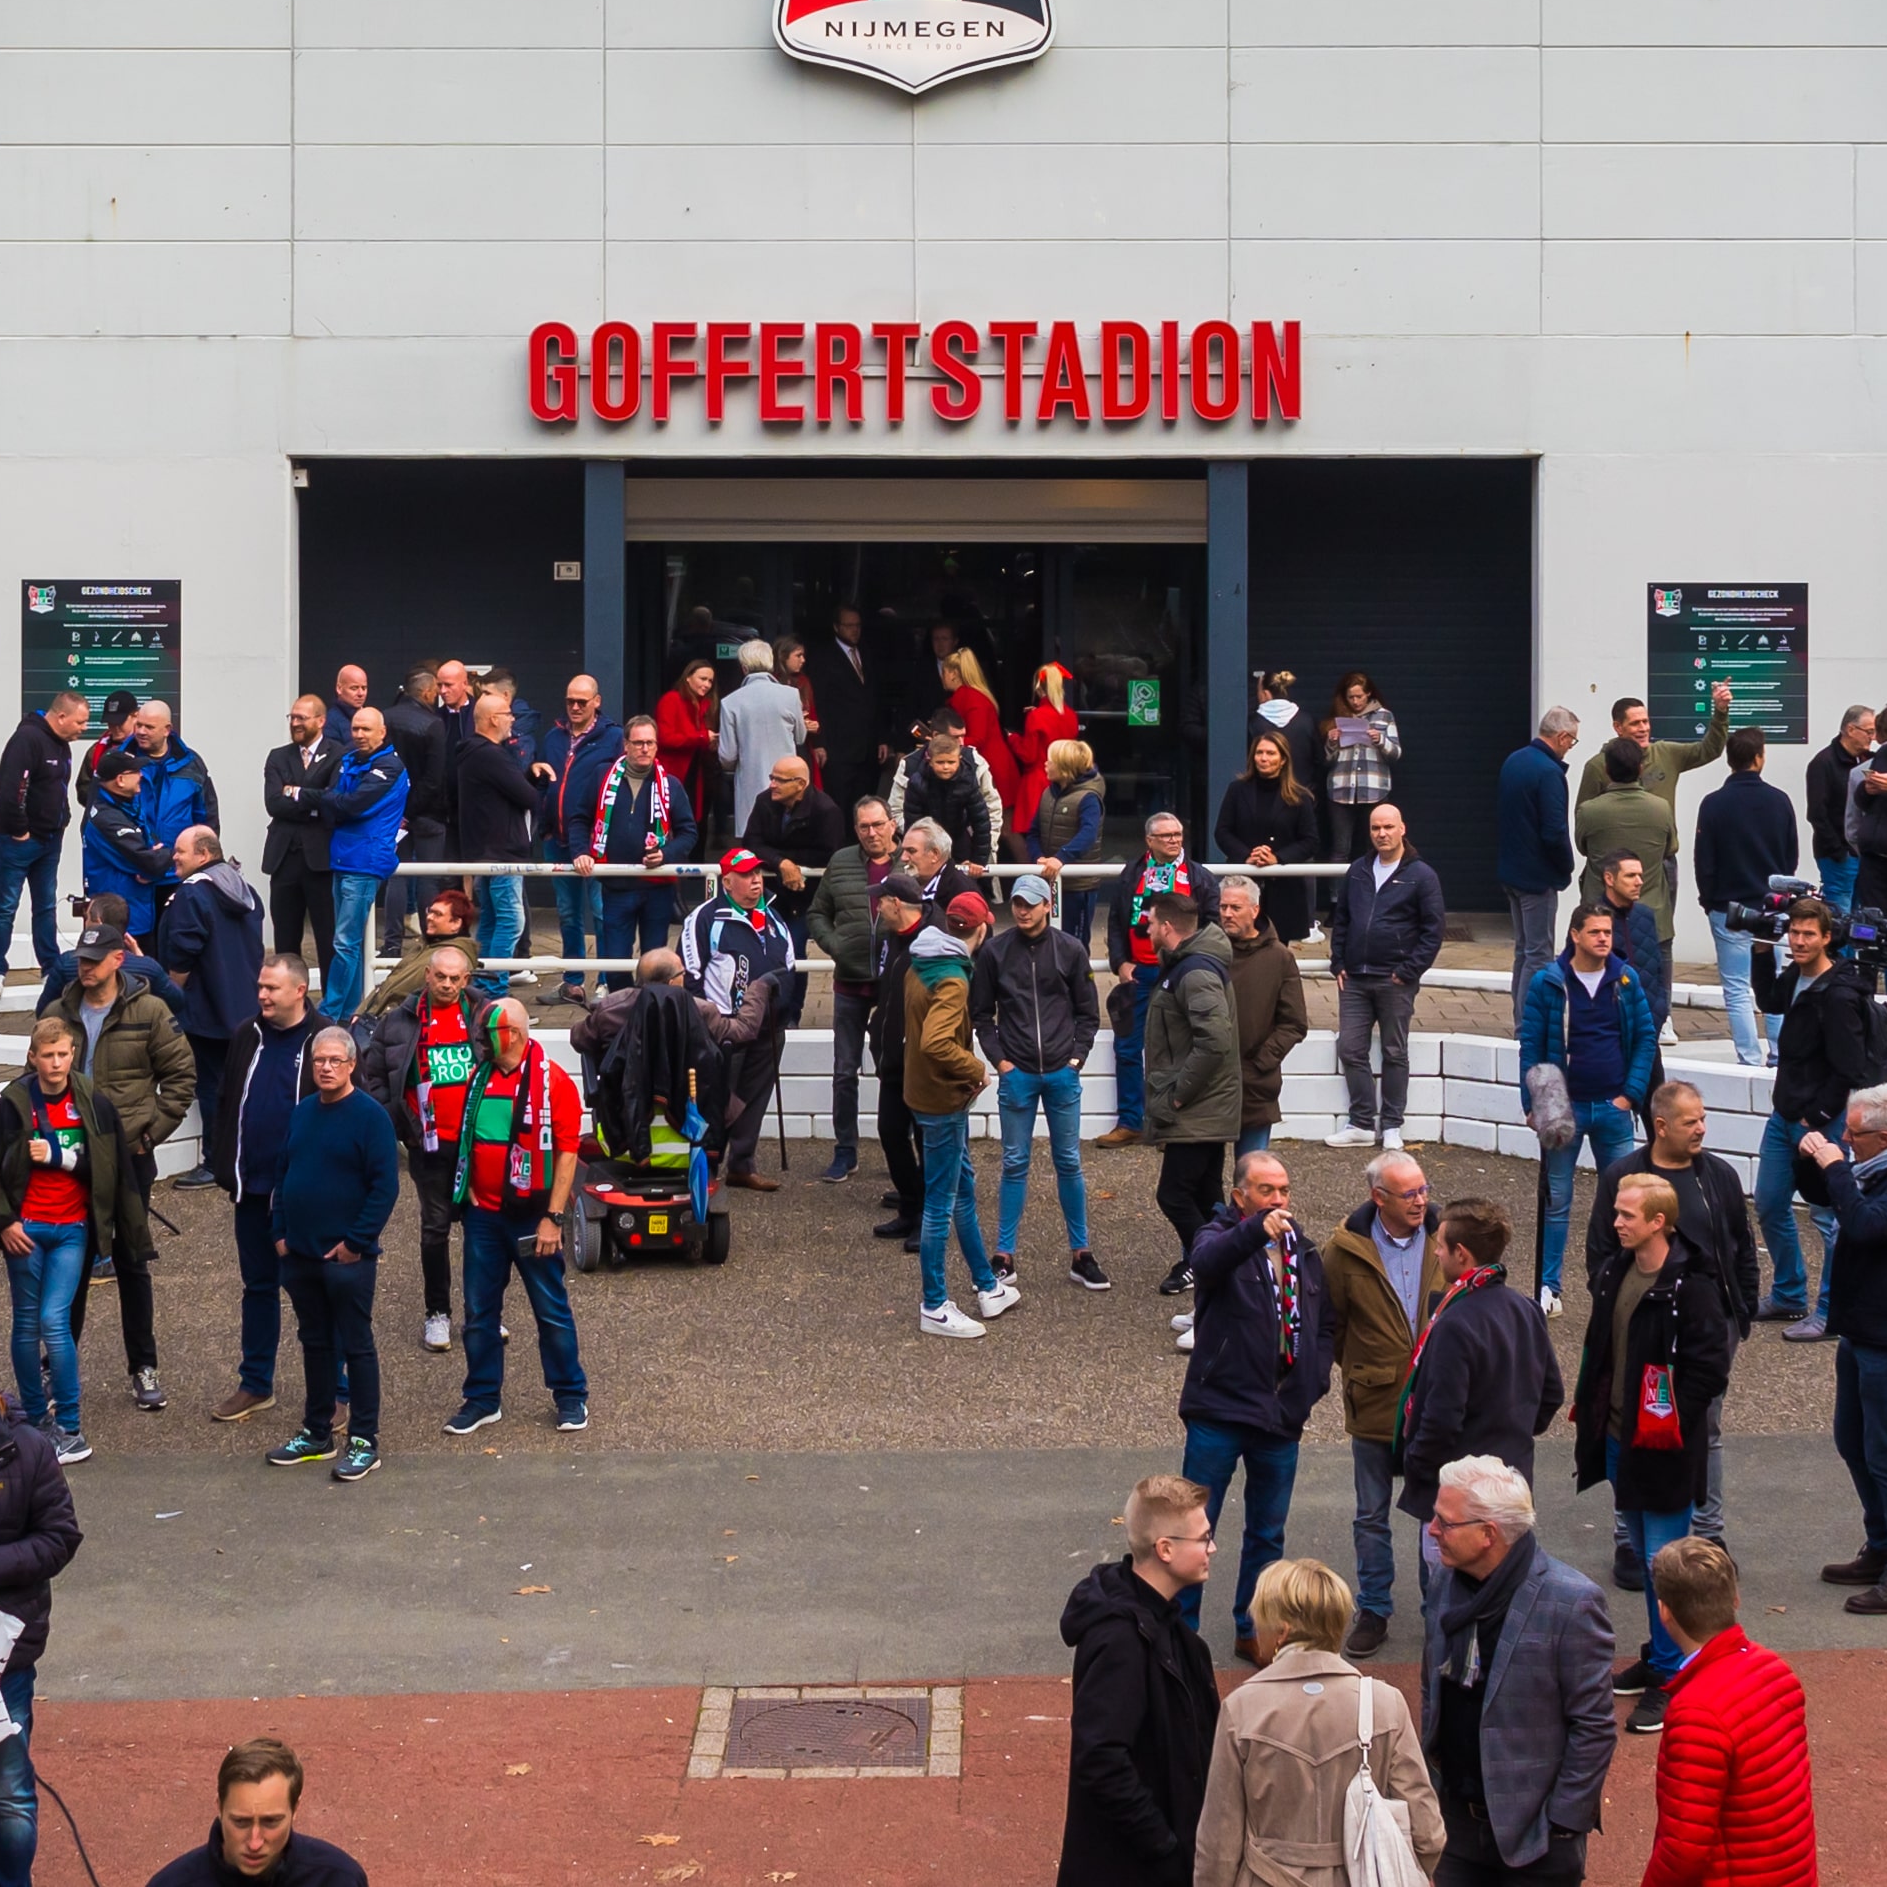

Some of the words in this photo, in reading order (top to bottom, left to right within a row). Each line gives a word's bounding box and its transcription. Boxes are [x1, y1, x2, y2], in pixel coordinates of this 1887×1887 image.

[824, 20, 1006, 38] NIJMEGEN
[867, 43, 914, 51] SINCE
[925, 43, 963, 51] 1900
[527, 319, 1302, 422] GOFFERTSTADION
[514, 1160, 531, 1176] NE
[1648, 1388, 1668, 1402] NE
